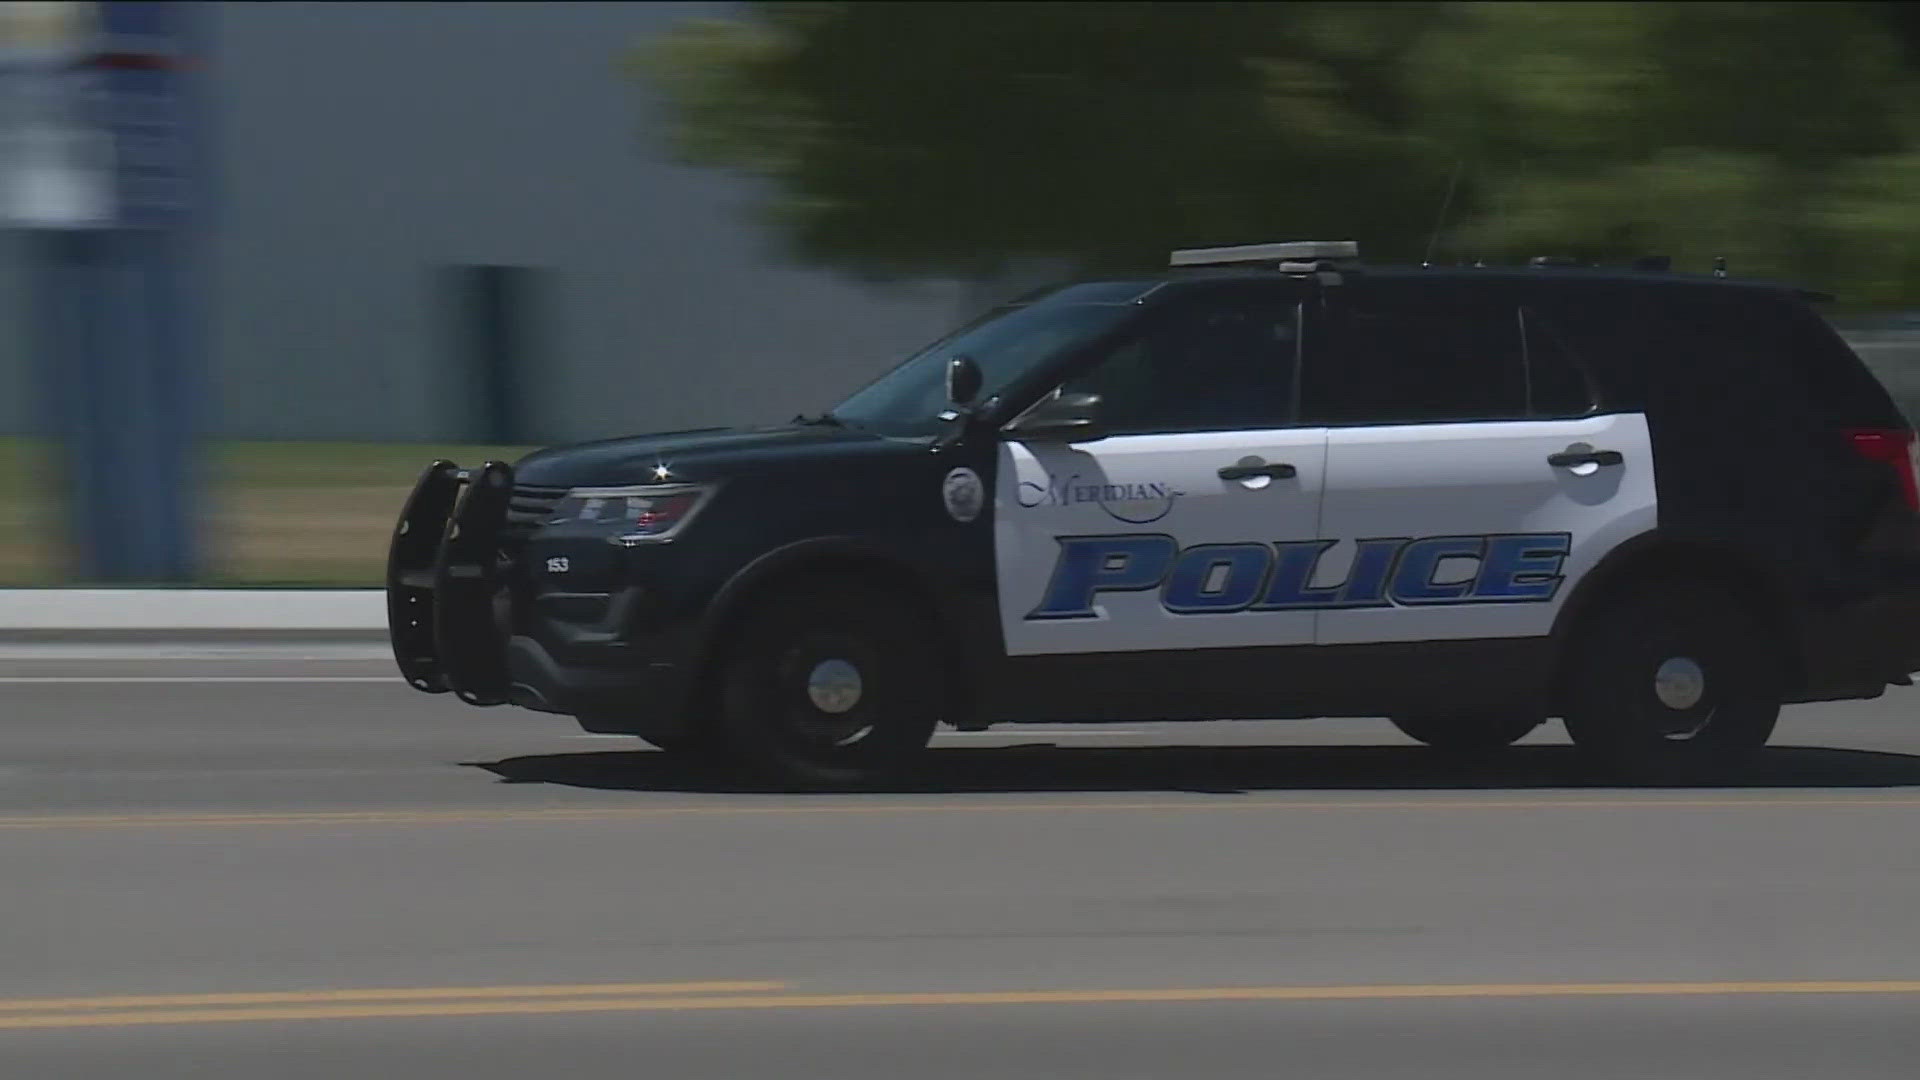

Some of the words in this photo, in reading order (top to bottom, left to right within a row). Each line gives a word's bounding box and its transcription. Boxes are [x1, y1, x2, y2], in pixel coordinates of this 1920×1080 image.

[1018, 474, 1168, 508] MERIDIAN
[547, 557, 569, 572] 153
[1024, 532, 1572, 620] POLICE
